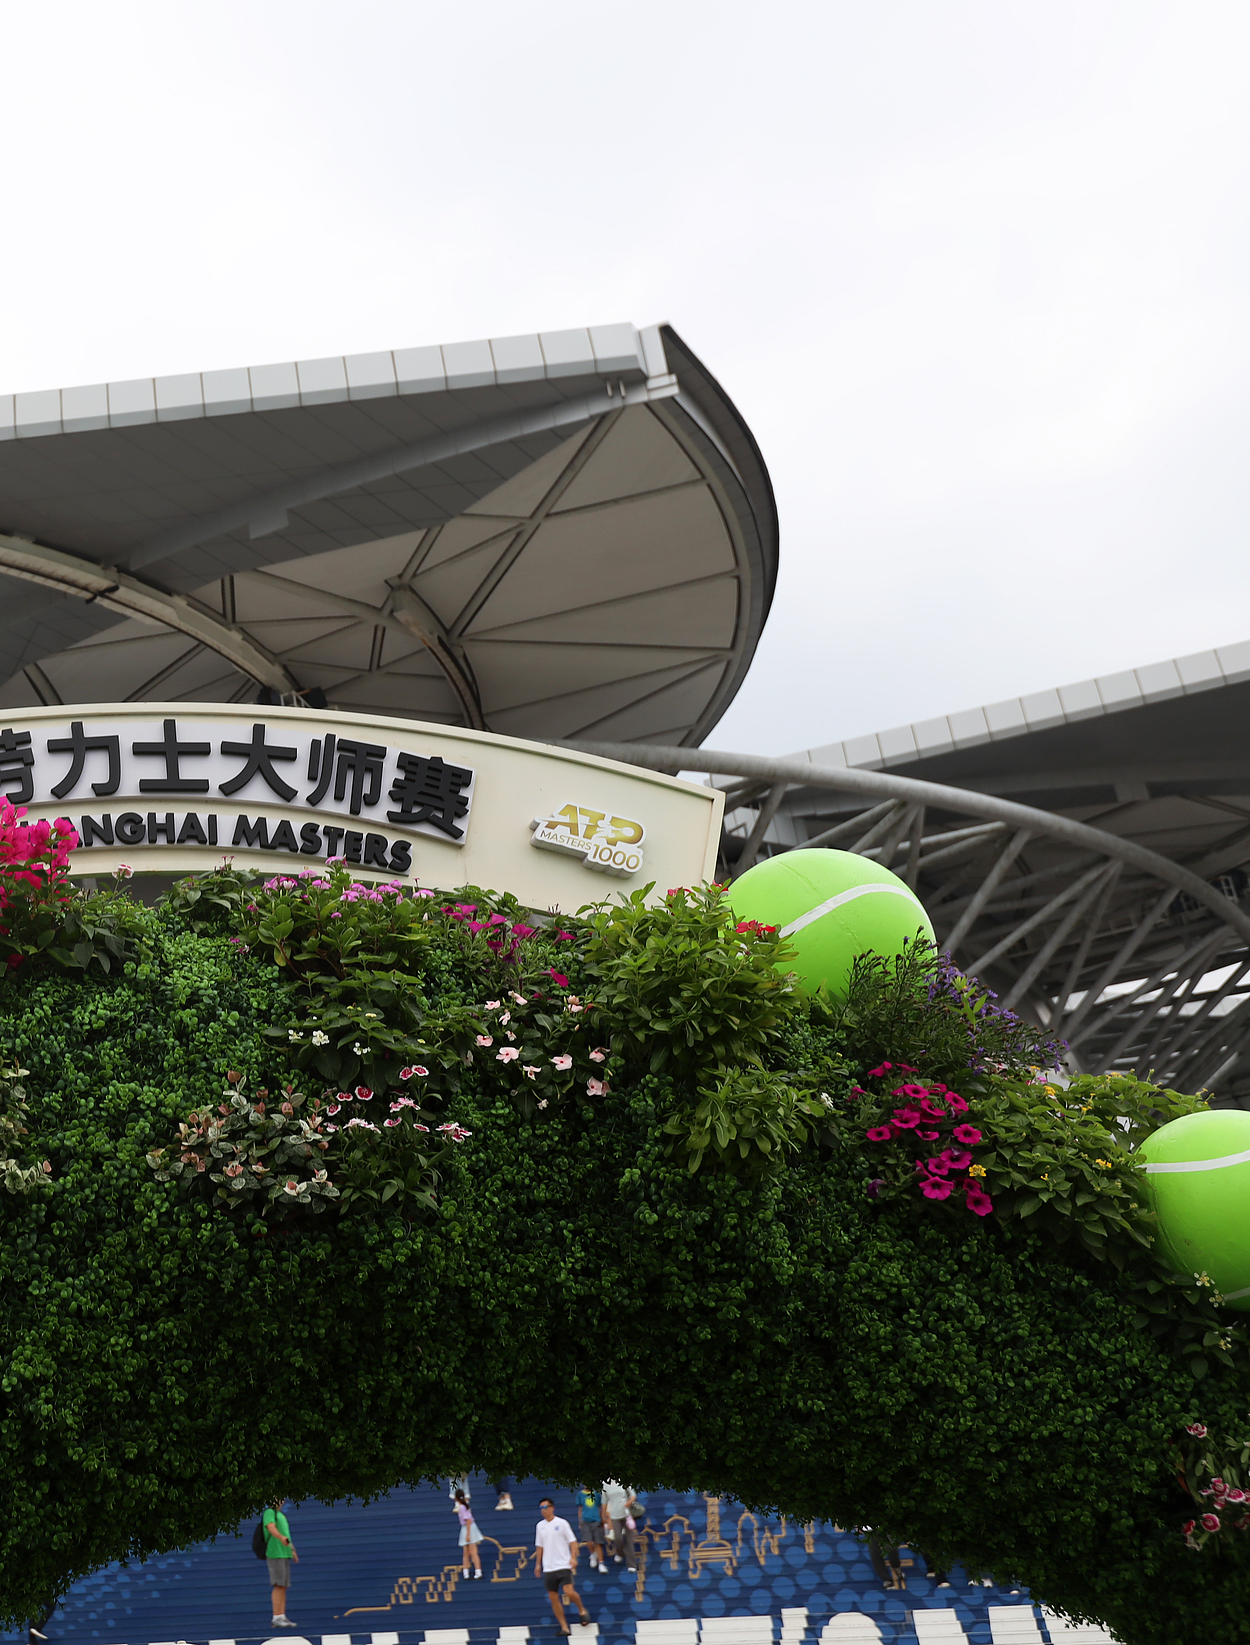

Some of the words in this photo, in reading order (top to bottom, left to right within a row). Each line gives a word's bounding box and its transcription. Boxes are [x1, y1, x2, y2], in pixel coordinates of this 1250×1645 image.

[232, 814, 412, 872] MASTERS
[544, 804, 643, 847] ATP
[540, 830, 592, 851] MASTERS
[592, 844, 640, 869] 1000
